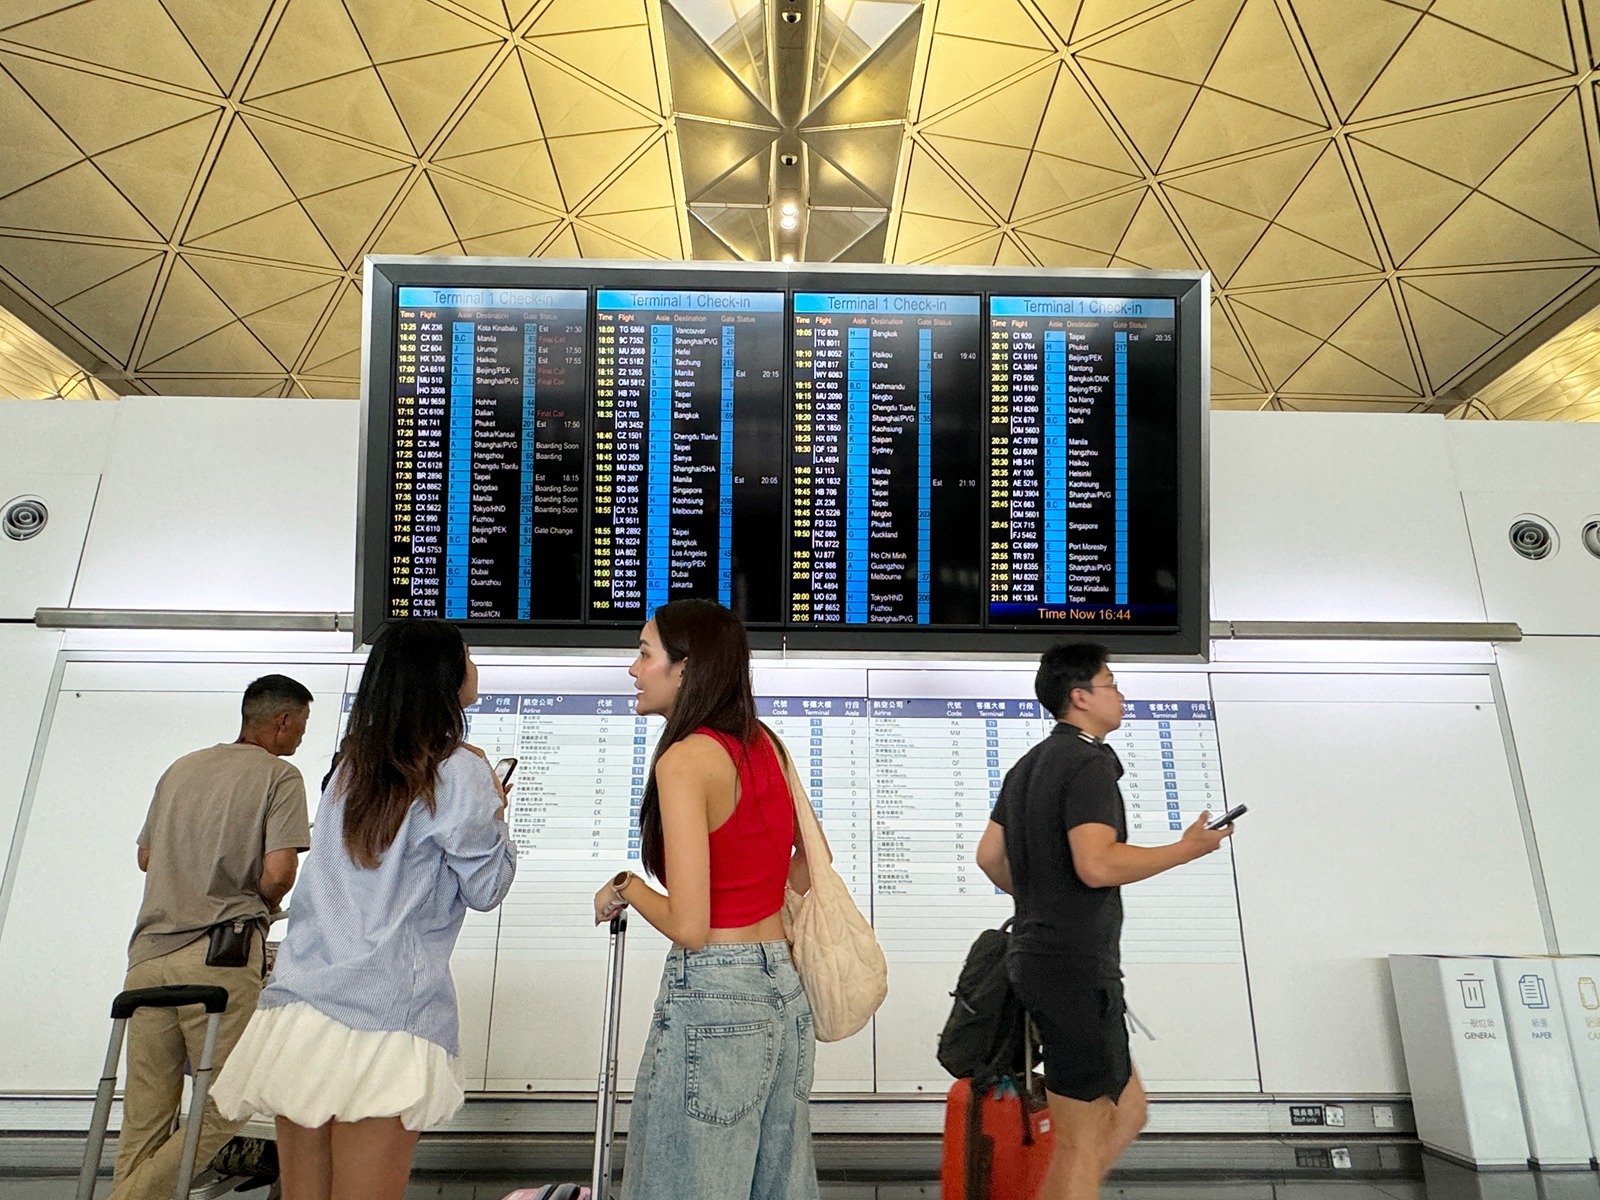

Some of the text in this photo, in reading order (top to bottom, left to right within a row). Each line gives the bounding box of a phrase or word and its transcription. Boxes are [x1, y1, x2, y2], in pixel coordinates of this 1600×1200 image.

[434, 291, 484, 304] Terminal
[500, 292, 552, 305] Check-in
[631, 294, 681, 306] Terminal
[697, 295, 750, 308] Check-in
[828, 297, 878, 310] Terminal
[894, 298, 947, 311] Check-in
[1024, 300, 1073, 313] Terminal
[1090, 301, 1142, 314] Check-in
[1038, 608, 1130, 620] Time Now 16:44
